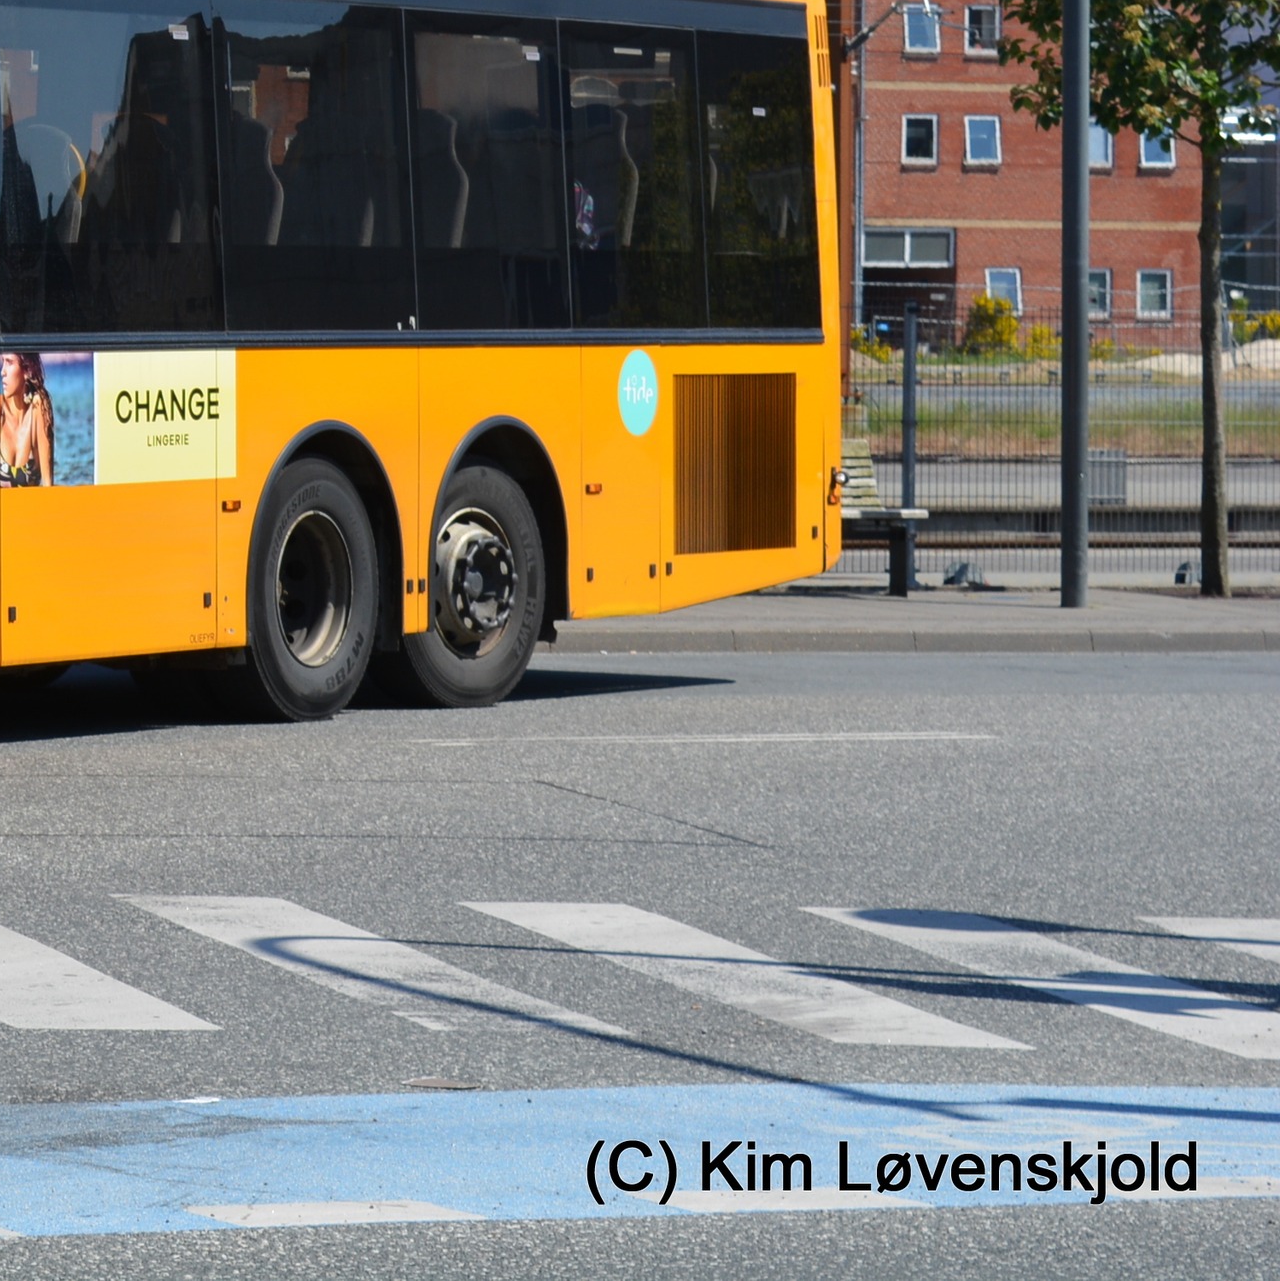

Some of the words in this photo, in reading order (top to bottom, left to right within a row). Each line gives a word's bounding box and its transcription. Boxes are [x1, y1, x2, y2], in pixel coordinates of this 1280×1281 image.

[623, 374, 654, 405] tide
[116, 388, 220, 424] CHANGE
[147, 434, 190, 447] LINGERIE
